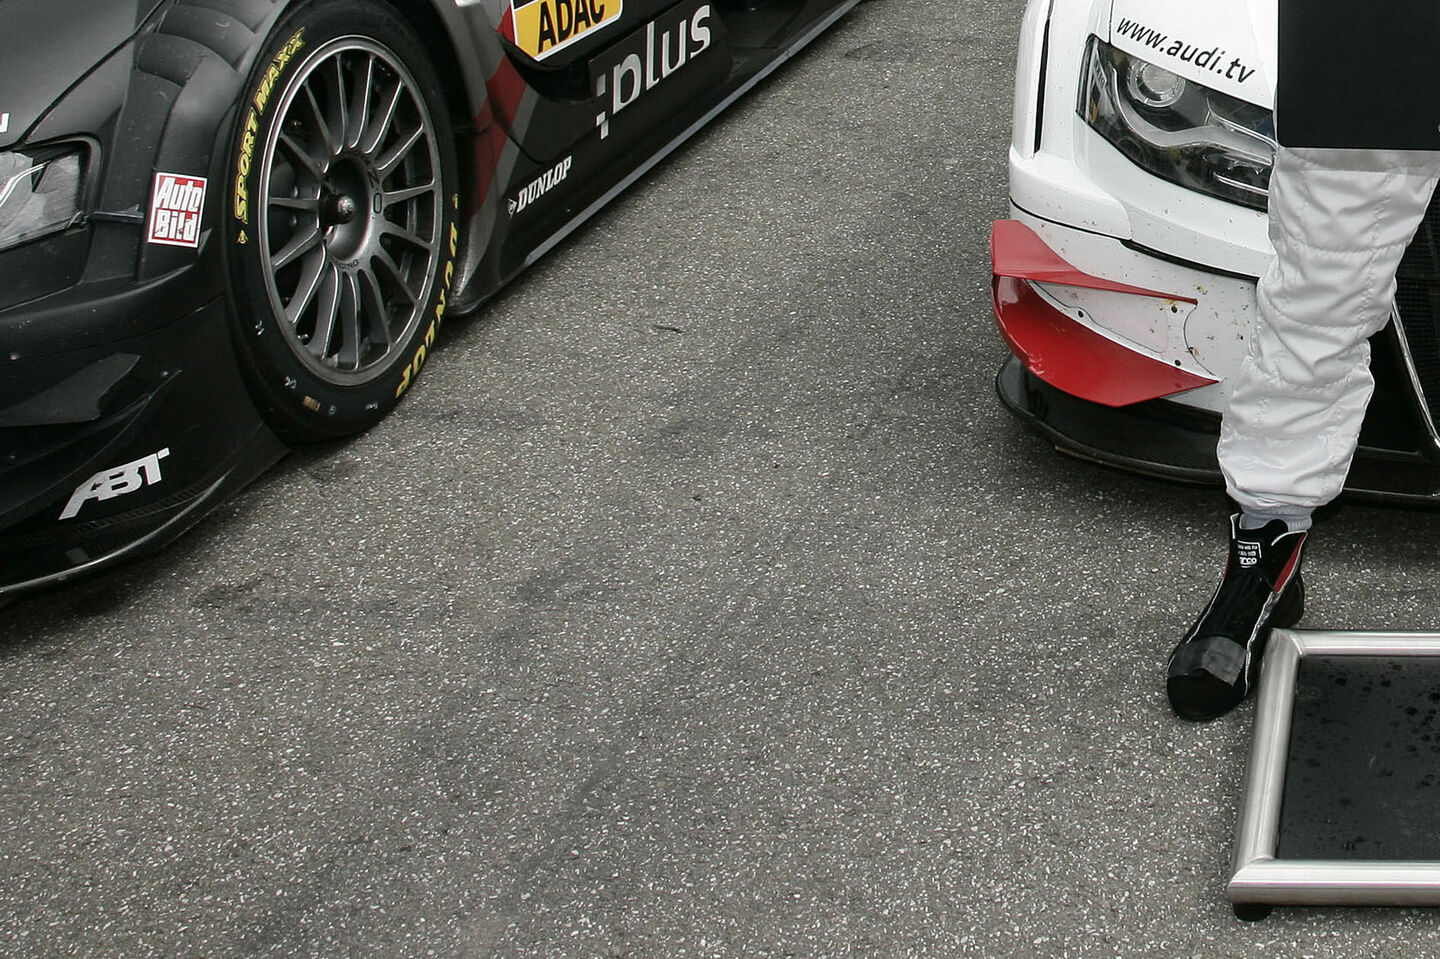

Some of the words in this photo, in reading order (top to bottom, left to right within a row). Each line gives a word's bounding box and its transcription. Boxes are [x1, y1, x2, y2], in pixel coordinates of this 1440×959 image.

[1115, 17, 1256, 85] www.audi.tv
[233, 106, 258, 224] SPORT
[253, 26, 306, 117] MAXX
[155, 176, 203, 212] Auto
[517, 156, 572, 212] DUNLOP
[154, 209, 197, 242] Bild
[396, 222, 459, 399] DUNLOP
[58, 447, 170, 521] ABT
